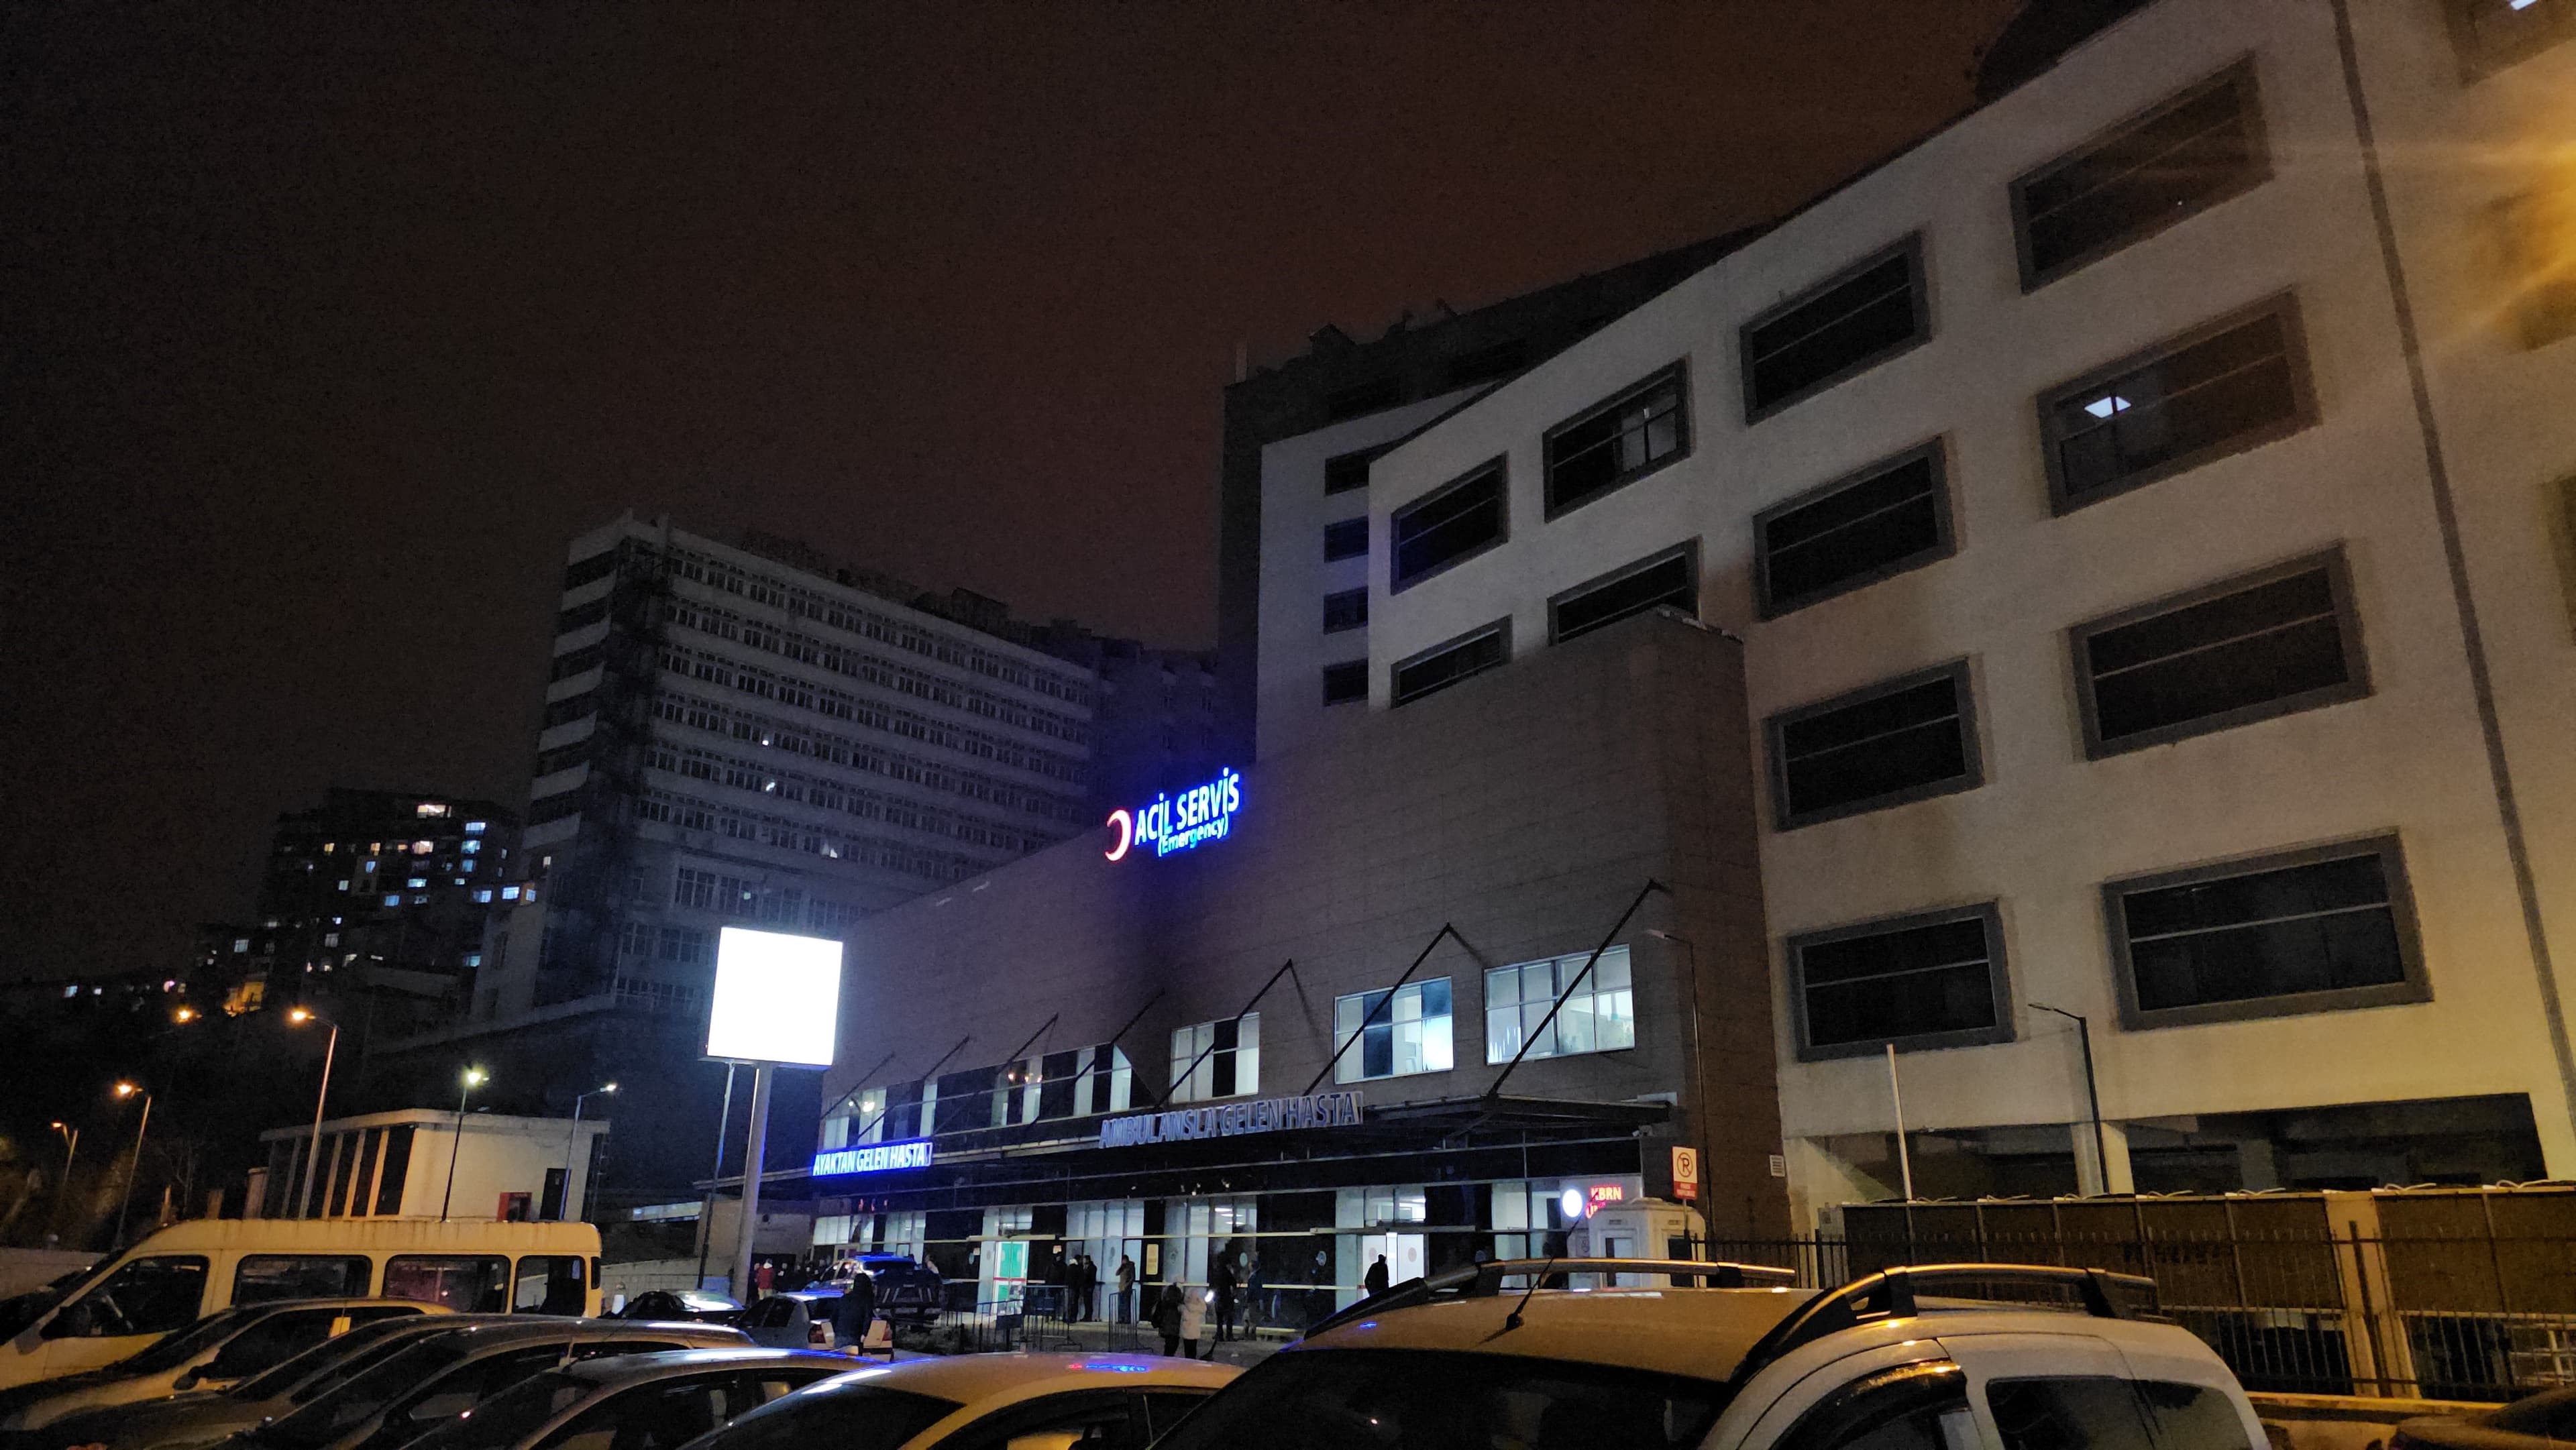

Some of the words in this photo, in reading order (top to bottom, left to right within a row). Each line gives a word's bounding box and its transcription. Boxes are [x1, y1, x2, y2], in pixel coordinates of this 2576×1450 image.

[1134, 793, 1173, 845] ACİL
[1177, 767, 1240, 830] SERVİS
[1158, 813, 1228, 856] (Emergency)
[1098, 1107, 1217, 1148] AMBULANSLA
[1220, 1102, 1281, 1135] GELEN
[1286, 1092, 1358, 1130] HASTA
[813, 1152, 855, 1176] AYAKTAN
[857, 1147, 889, 1172] GELEN
[890, 1143, 927, 1169] HASTA
[1591, 1186, 1622, 1201] KBRN
